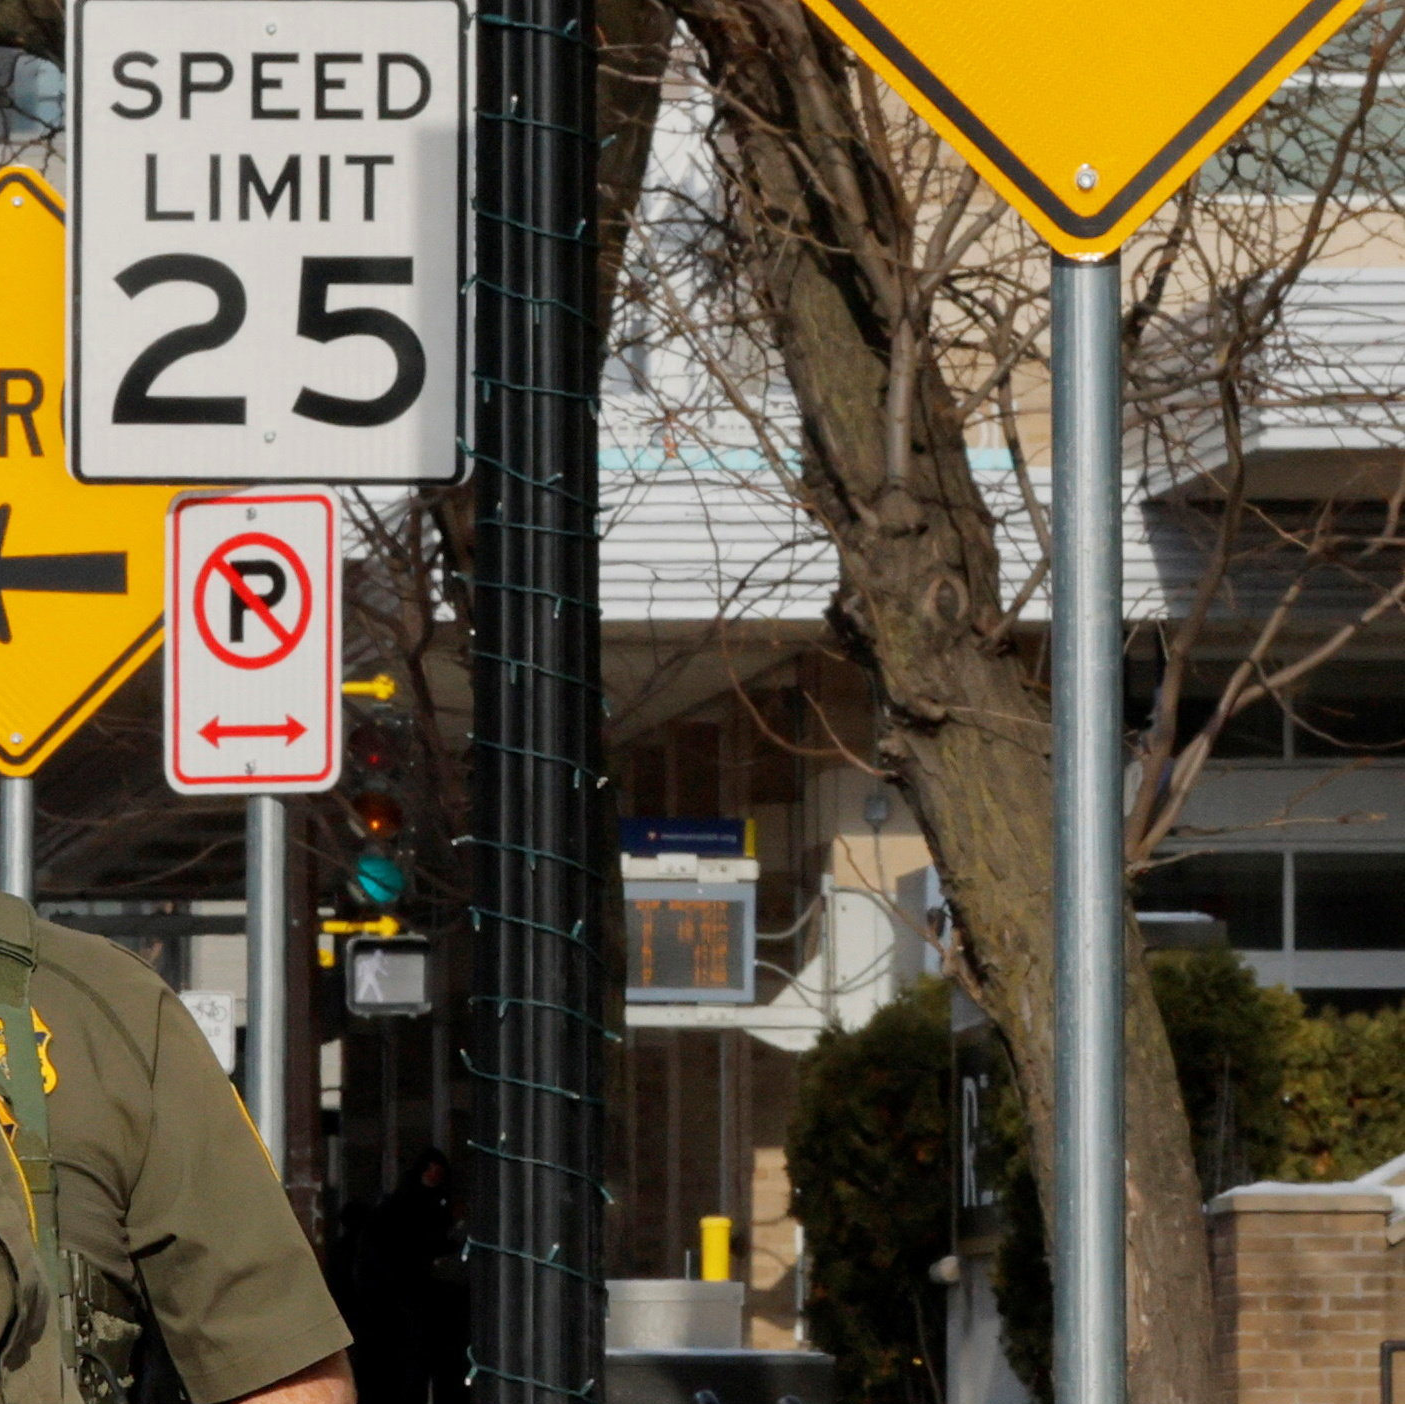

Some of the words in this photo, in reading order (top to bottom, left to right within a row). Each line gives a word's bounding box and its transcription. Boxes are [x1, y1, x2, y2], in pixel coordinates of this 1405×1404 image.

[110, 51, 432, 120] SPEED
[145, 153, 394, 222] LIMIT
[111, 253, 426, 427] 25
